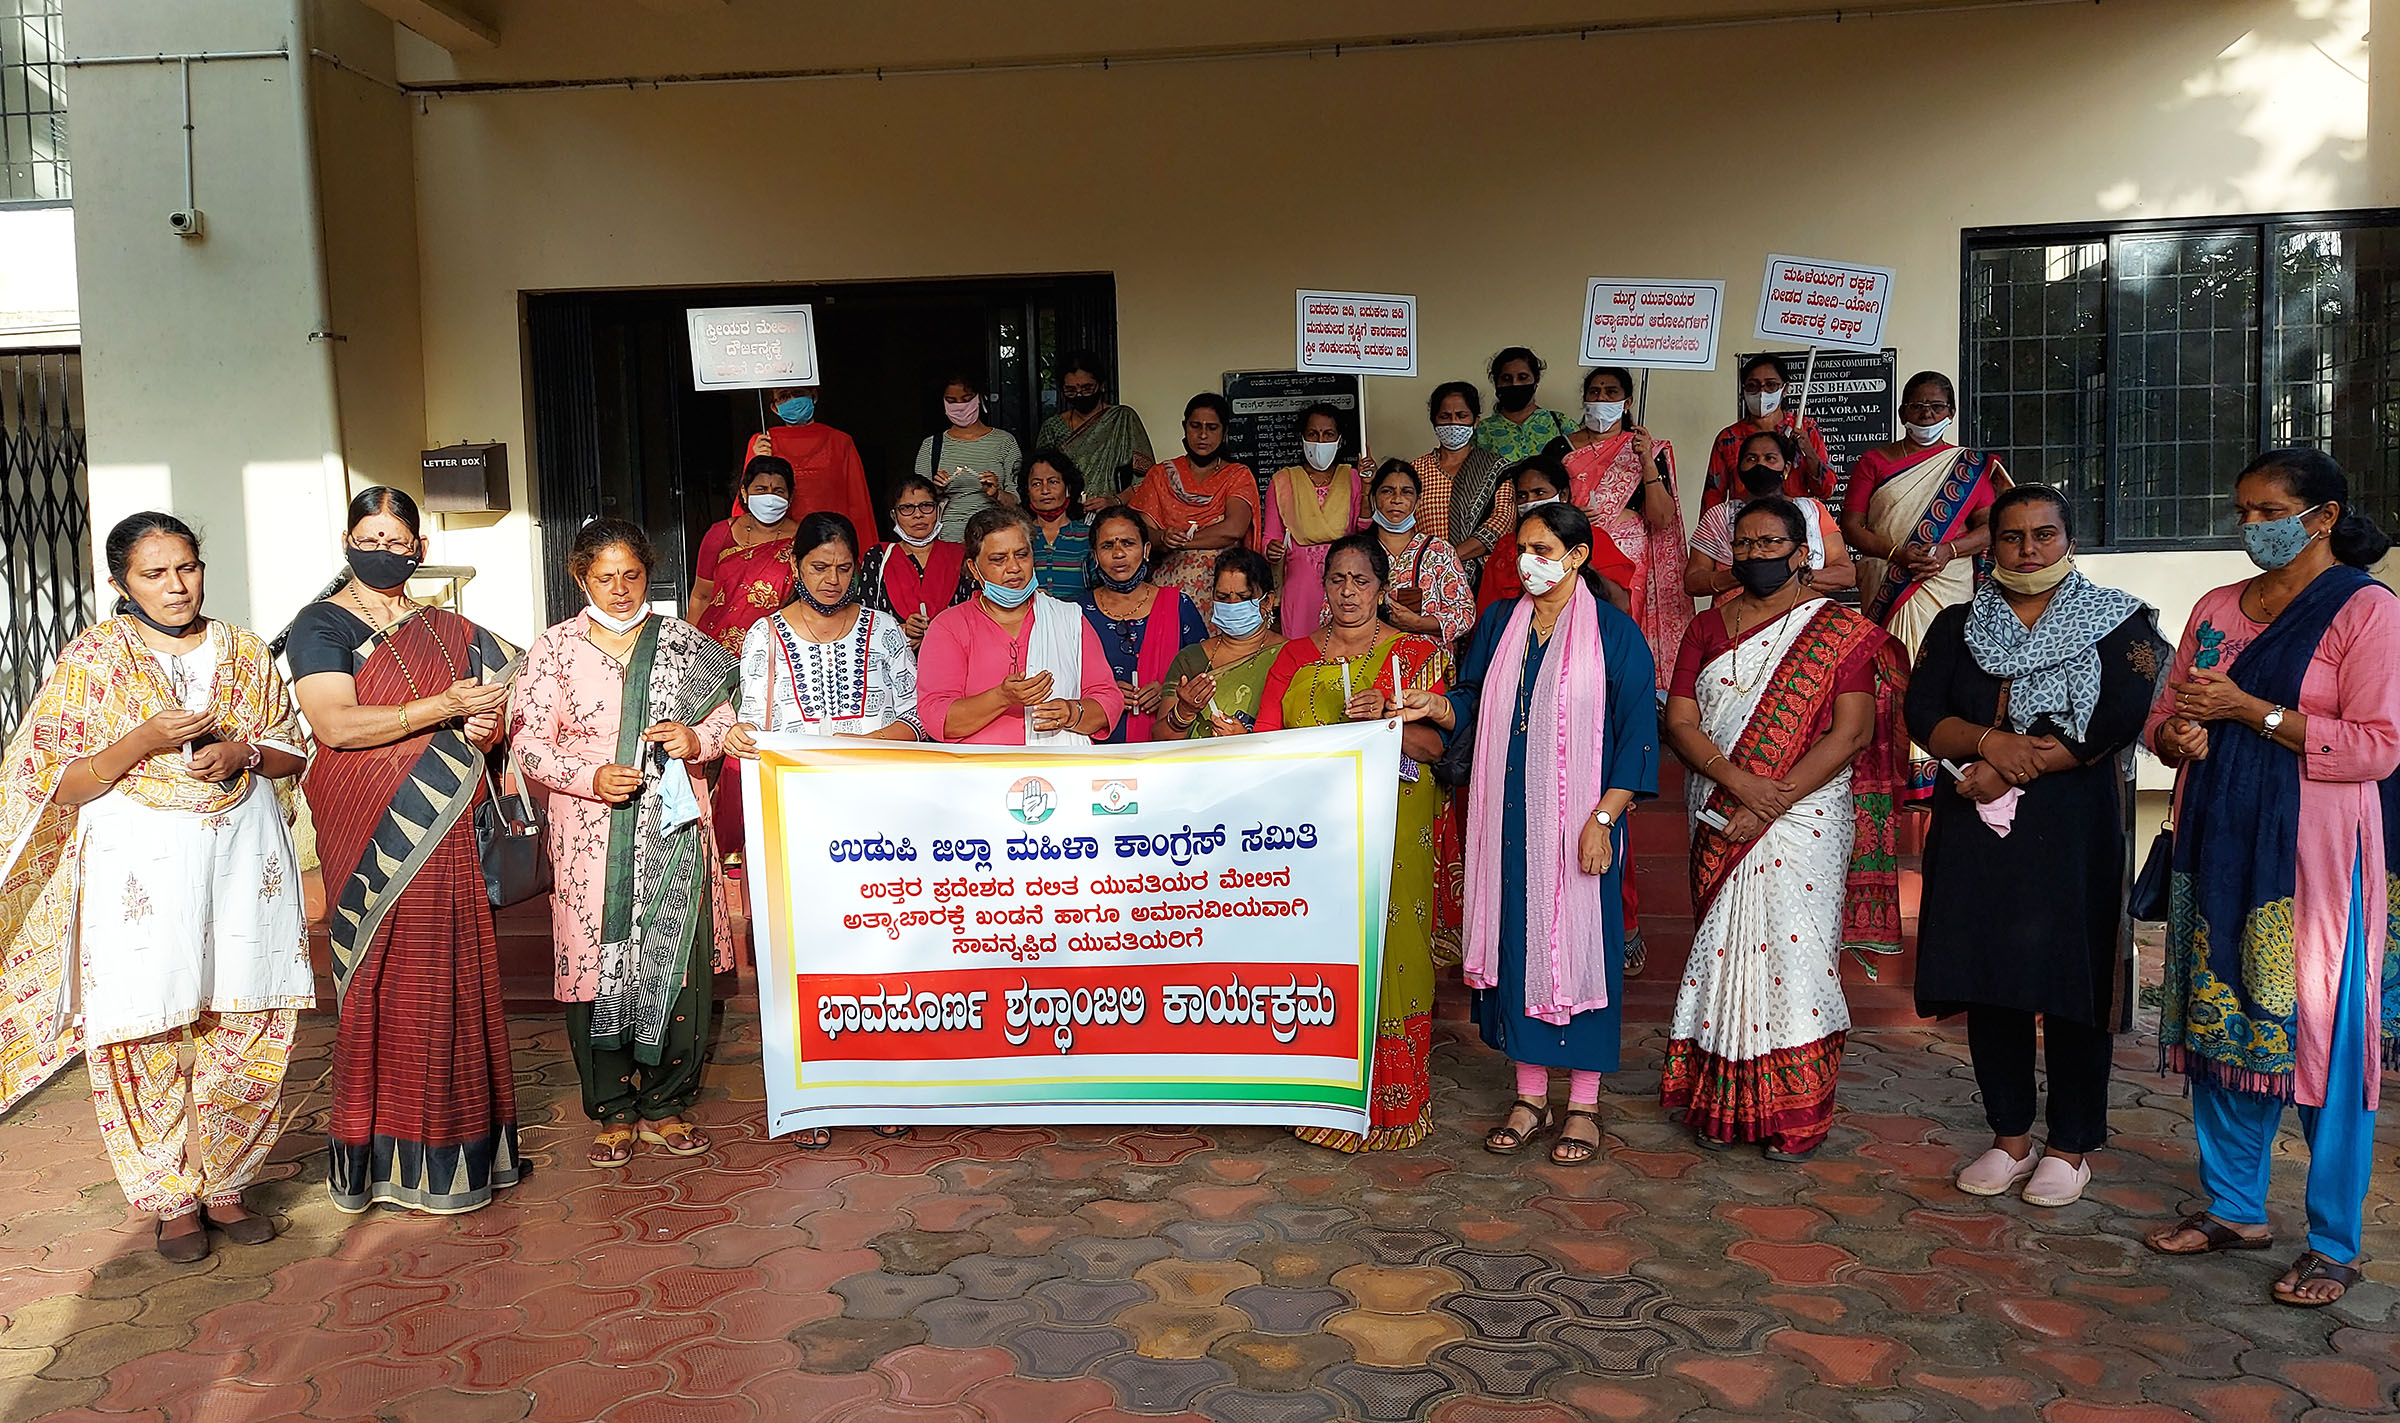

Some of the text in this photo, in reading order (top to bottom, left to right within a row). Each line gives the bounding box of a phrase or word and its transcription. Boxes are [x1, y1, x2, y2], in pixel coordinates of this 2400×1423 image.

[1783, 267, 1876, 297] ಮಹಿಳೆಯರಿಗೆ ರಕ್ಷಣೆ
[1641, 290, 1696, 306] ಯುವತಿಯರ
[1770, 288, 1880, 314] ನೀಡದ ಮೋದಿ-ಯೋಗಿ
[1309, 302, 1339, 316] ಬದುಕಲು
[1360, 306, 1389, 318] ಬದುಕಲು
[1306, 322, 1344, 335] ಮನುಕುಲದ
[1594, 312, 1645, 333] ಅತ್ಯಾಚಾರದ
[1780, 310, 1863, 338] ಸರ್ಕಾರಕ್ಕೆ ಧಿಕ್ಕಾರ
[1364, 343, 1393, 356] ಬದುಕಲು
[1598, 334, 1618, 352] ಗಲ್ಲು
[1786, 362, 1806, 370] TRICT
[1842, 358, 1882, 368] COMMITTEE
[1838, 396, 1849, 404] By
[1830, 406, 1858, 415] VORA
[1848, 432, 1889, 442] KHARGE
[424, 458, 480, 467] LETTER BOX
[829, 820, 1318, 872] ಉಡುಪಿ ಜಿಲ್ಲಾ ಮಹಿಳಾ ಕಾಂಗ್ರೆಸ್ ಸಮಿತಿ
[860, 866, 1290, 904] ಉತ್ತರ ಪ್ರದೇಶದ ದಲಿತ ಯುವತಿಯರ ಮೇಲಿನ
[843, 896, 1308, 940] ಅತ್ಯಾಚಾರಕ್ಕೆ ಖಂಡನೆ ಹಾಗೂ ಅಮಾನವೀಯವಾಗಿ
[952, 927, 1204, 962] ಸಾವನ್ನಪ್ಪಿದ ಯುವತಿಯರಿಗೆ
[818, 972, 1336, 1054] ಭಾವಪೂರ್ಣ ಶ್ರದ್ಧಾಂಜಲಿ ಕಾರ್ಯಕ್ರಮ
